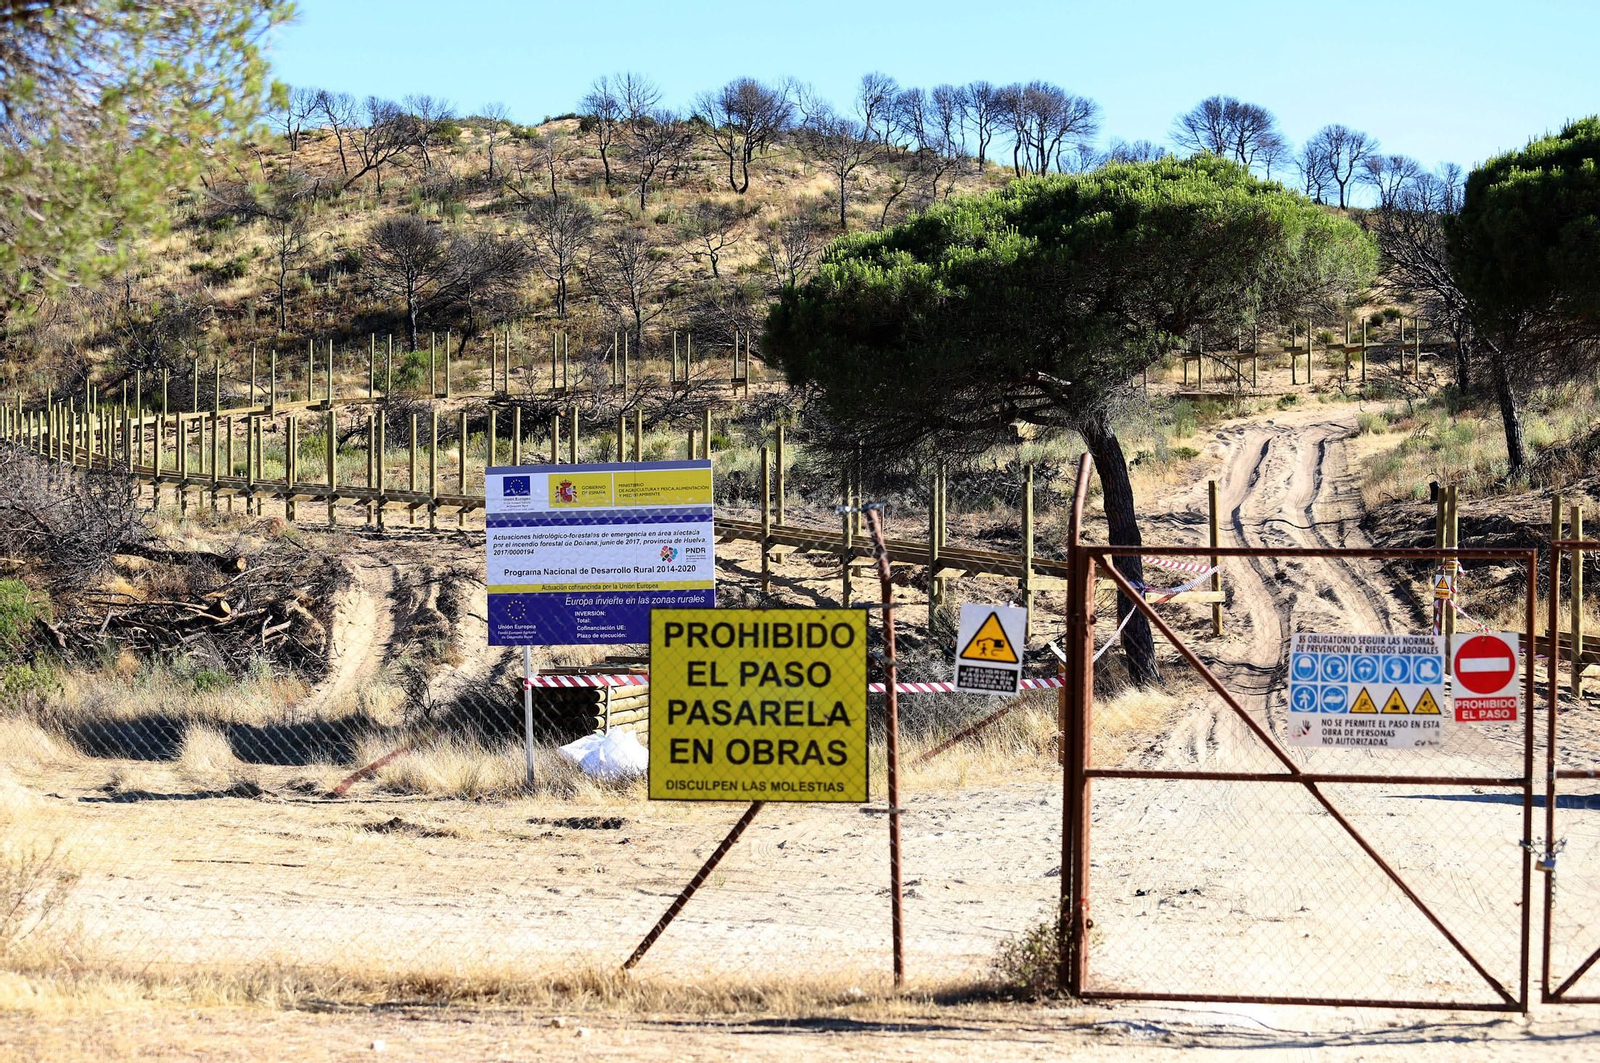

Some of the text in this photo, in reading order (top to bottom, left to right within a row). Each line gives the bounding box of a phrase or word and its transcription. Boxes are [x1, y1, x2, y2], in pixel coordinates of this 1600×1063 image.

[532, 532, 600, 541] hidrológico-forestales
[610, 530, 647, 539] emergencia
[512, 540, 539, 548] incendio
[539, 539, 564, 547] forestal
[599, 538, 615, 547] junio
[643, 536, 673, 545] provincia
[493, 548, 535, 556] 2017/0000194
[504, 564, 697, 577] Programa Nacional de Desarrollo Rural 2014-2020
[602, 583, 612, 591] por
[612, 582, 618, 590] la
[620, 581, 635, 589] Unión
[636, 581, 659, 589] Europea
[565, 594, 705, 607] Europa invierte en las zonas rurales
[600, 632, 627, 640] ejecución:
[664, 622, 855, 649] PROHIBIDO
[1307, 635, 1356, 645] OBLIGATORIO
[1358, 636, 1386, 645] SEGUIR
[1387, 636, 1400, 645] LAS
[1402, 637, 1435, 645] NORMAS
[1295, 644, 1305, 652] DE
[1306, 645, 1351, 653] PREVENCION
[1365, 645, 1396, 654] RIESGOS
[1398, 646, 1439, 654] LABORALES
[687, 661, 832, 688] EL PASO
[1455, 699, 1516, 709] PROHIBIDO
[668, 700, 851, 727] PASARELA
[1462, 709, 1510, 719] EL PASO
[1321, 719, 1440, 728] NO SE PERMITE EL PASO EN ESTA
[1321, 728, 1395, 737] OBRA DE PERSONAS
[1321, 737, 1388, 746] NO AUTORIZADAS
[670, 738, 848, 766] EN OBRAS
[665, 780, 845, 793] DISCULPEN LAS MOLESTIAS
